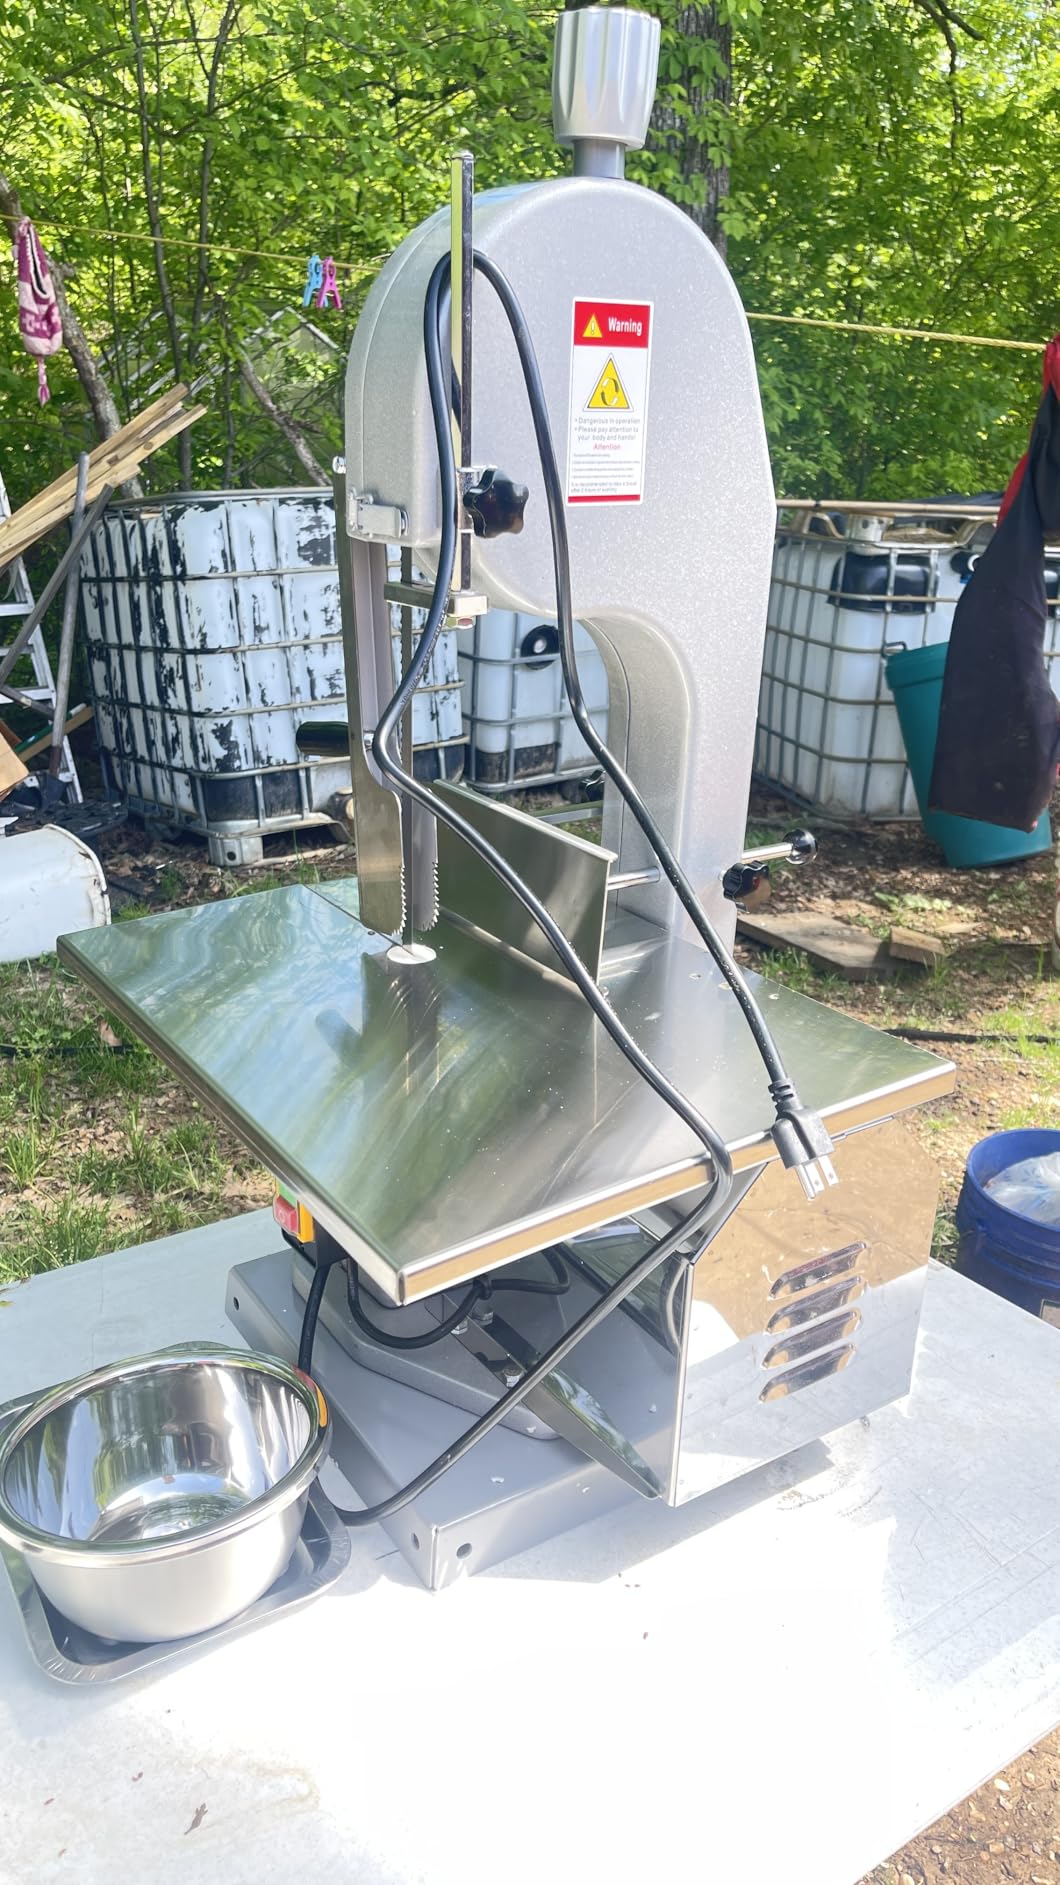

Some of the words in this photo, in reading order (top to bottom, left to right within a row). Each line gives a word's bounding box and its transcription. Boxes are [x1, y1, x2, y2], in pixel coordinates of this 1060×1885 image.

[608, 317, 642, 336] Warning
[578, 416, 608, 425] Dangerous
[578, 434, 590, 442] your
[592, 434, 606, 442] body
